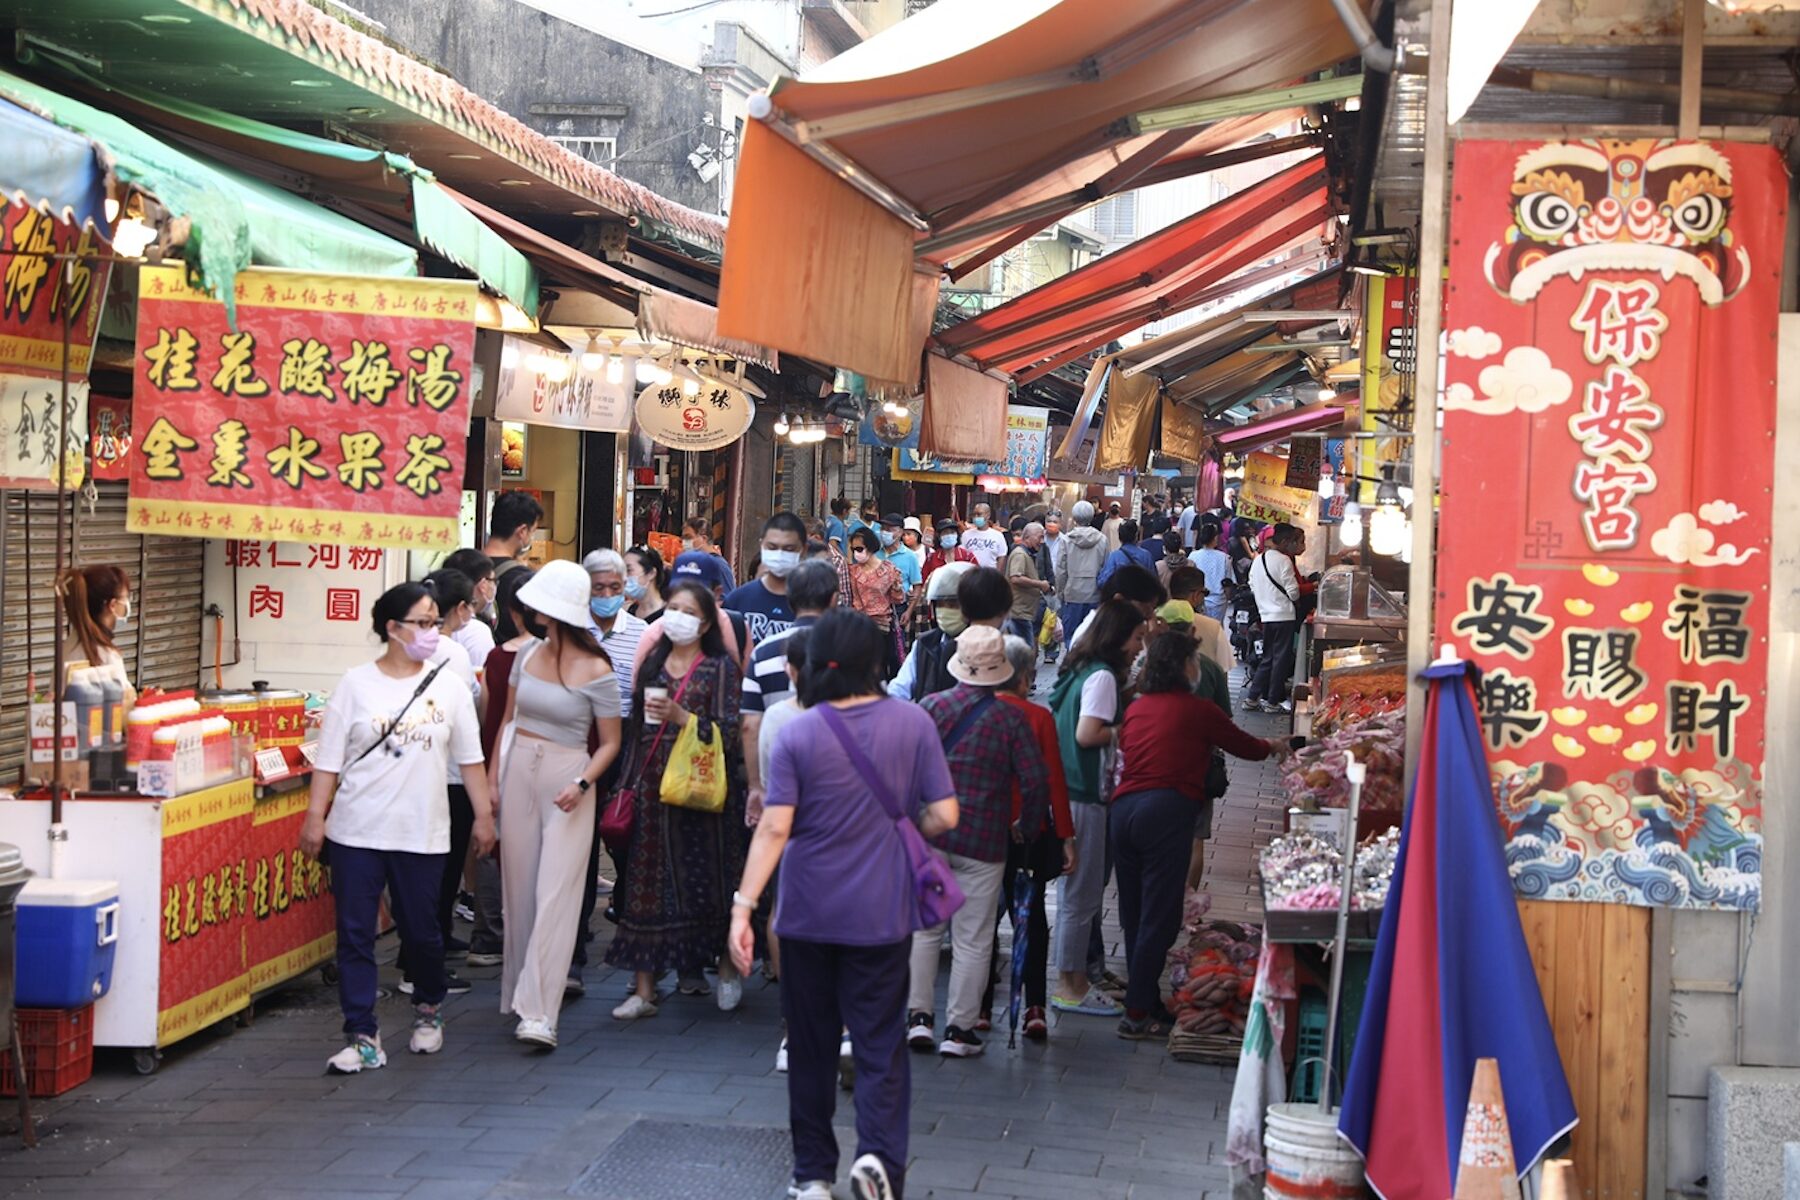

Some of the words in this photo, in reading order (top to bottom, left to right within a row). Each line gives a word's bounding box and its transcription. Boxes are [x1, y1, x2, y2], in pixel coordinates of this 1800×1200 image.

[0, 200, 98, 325] 梅湯
[147, 276, 249, 300] 唐山味
[260, 284, 359, 309] 唐山伯古味
[370, 291, 472, 316] 唐山伯古味
[143, 327, 463, 409] 桂花酸梅湯
[1571, 282, 1665, 549] 保安宮
[134, 506, 235, 530] 唐山伯古味
[247, 513, 346, 538] 唐山伯古味
[357, 521, 454, 545] 唐山伯古味
[225, 539, 384, 570] 蝦仁河粉
[1456, 578, 1549, 748] 安樂
[1567, 632, 1644, 700] 賜
[1669, 588, 1749, 758] 福財
